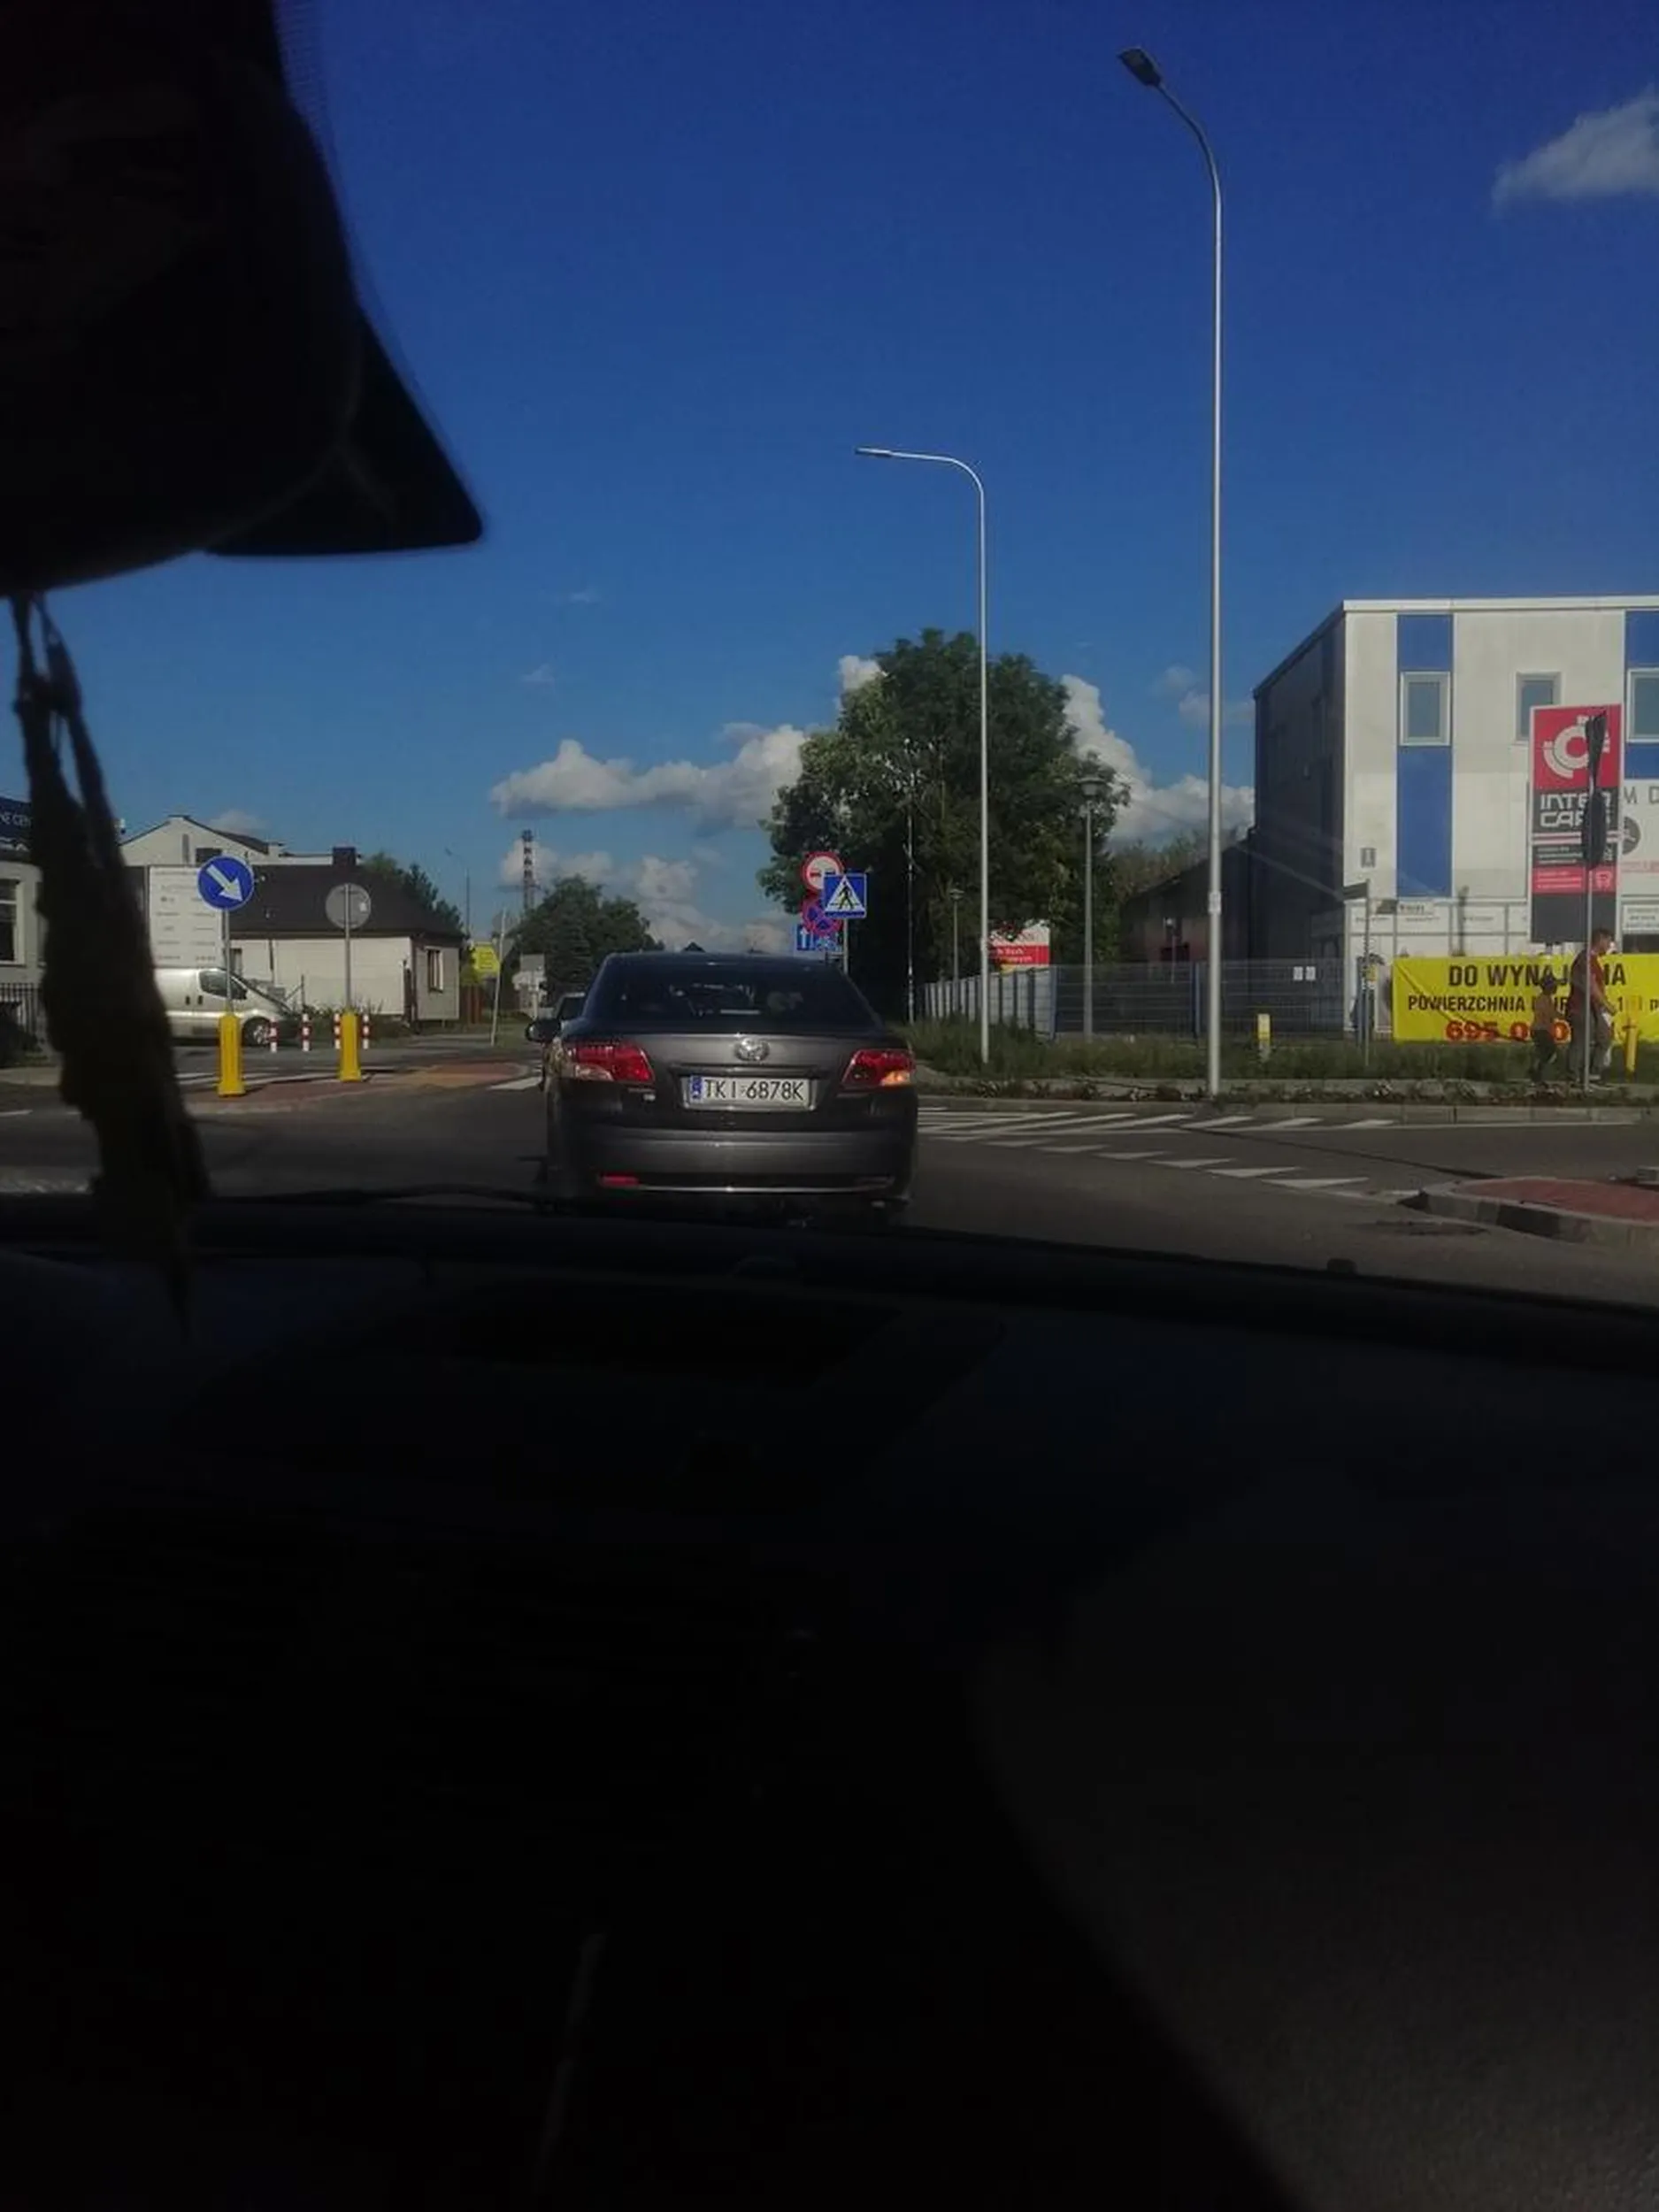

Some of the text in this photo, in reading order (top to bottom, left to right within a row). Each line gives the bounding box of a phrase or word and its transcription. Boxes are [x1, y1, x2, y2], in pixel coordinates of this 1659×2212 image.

[1448, 964, 1626, 987] DO WYNAJIA
[1408, 995, 1526, 1011] POWIERZCHNIA
[704, 1079, 804, 1101] TKI 6878K
